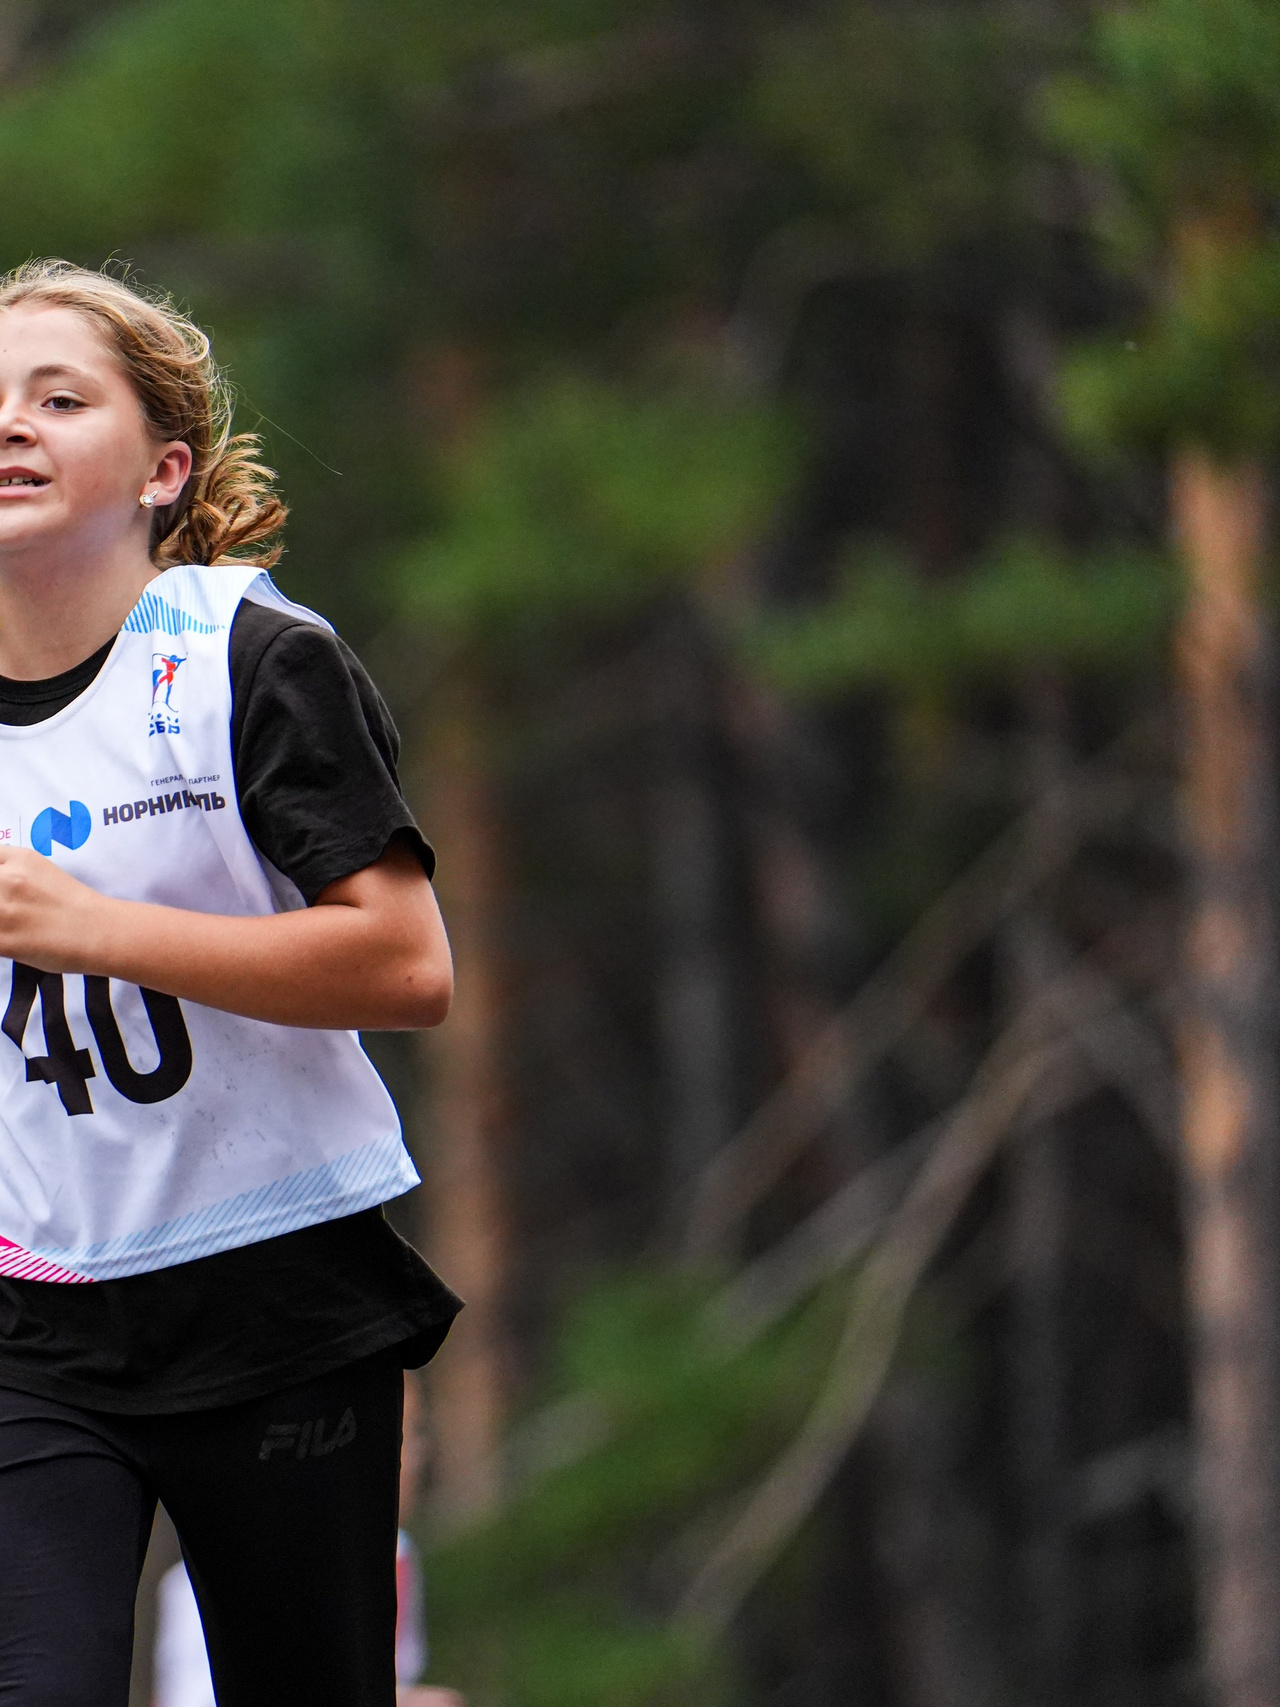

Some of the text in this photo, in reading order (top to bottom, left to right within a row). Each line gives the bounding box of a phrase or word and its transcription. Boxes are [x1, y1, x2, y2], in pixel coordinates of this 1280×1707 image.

[188, 774, 221, 785] ПАРТНЕР
[102, 789, 226, 826] НОРНИКЛЬ
[259, 1405, 358, 1461] FILA
